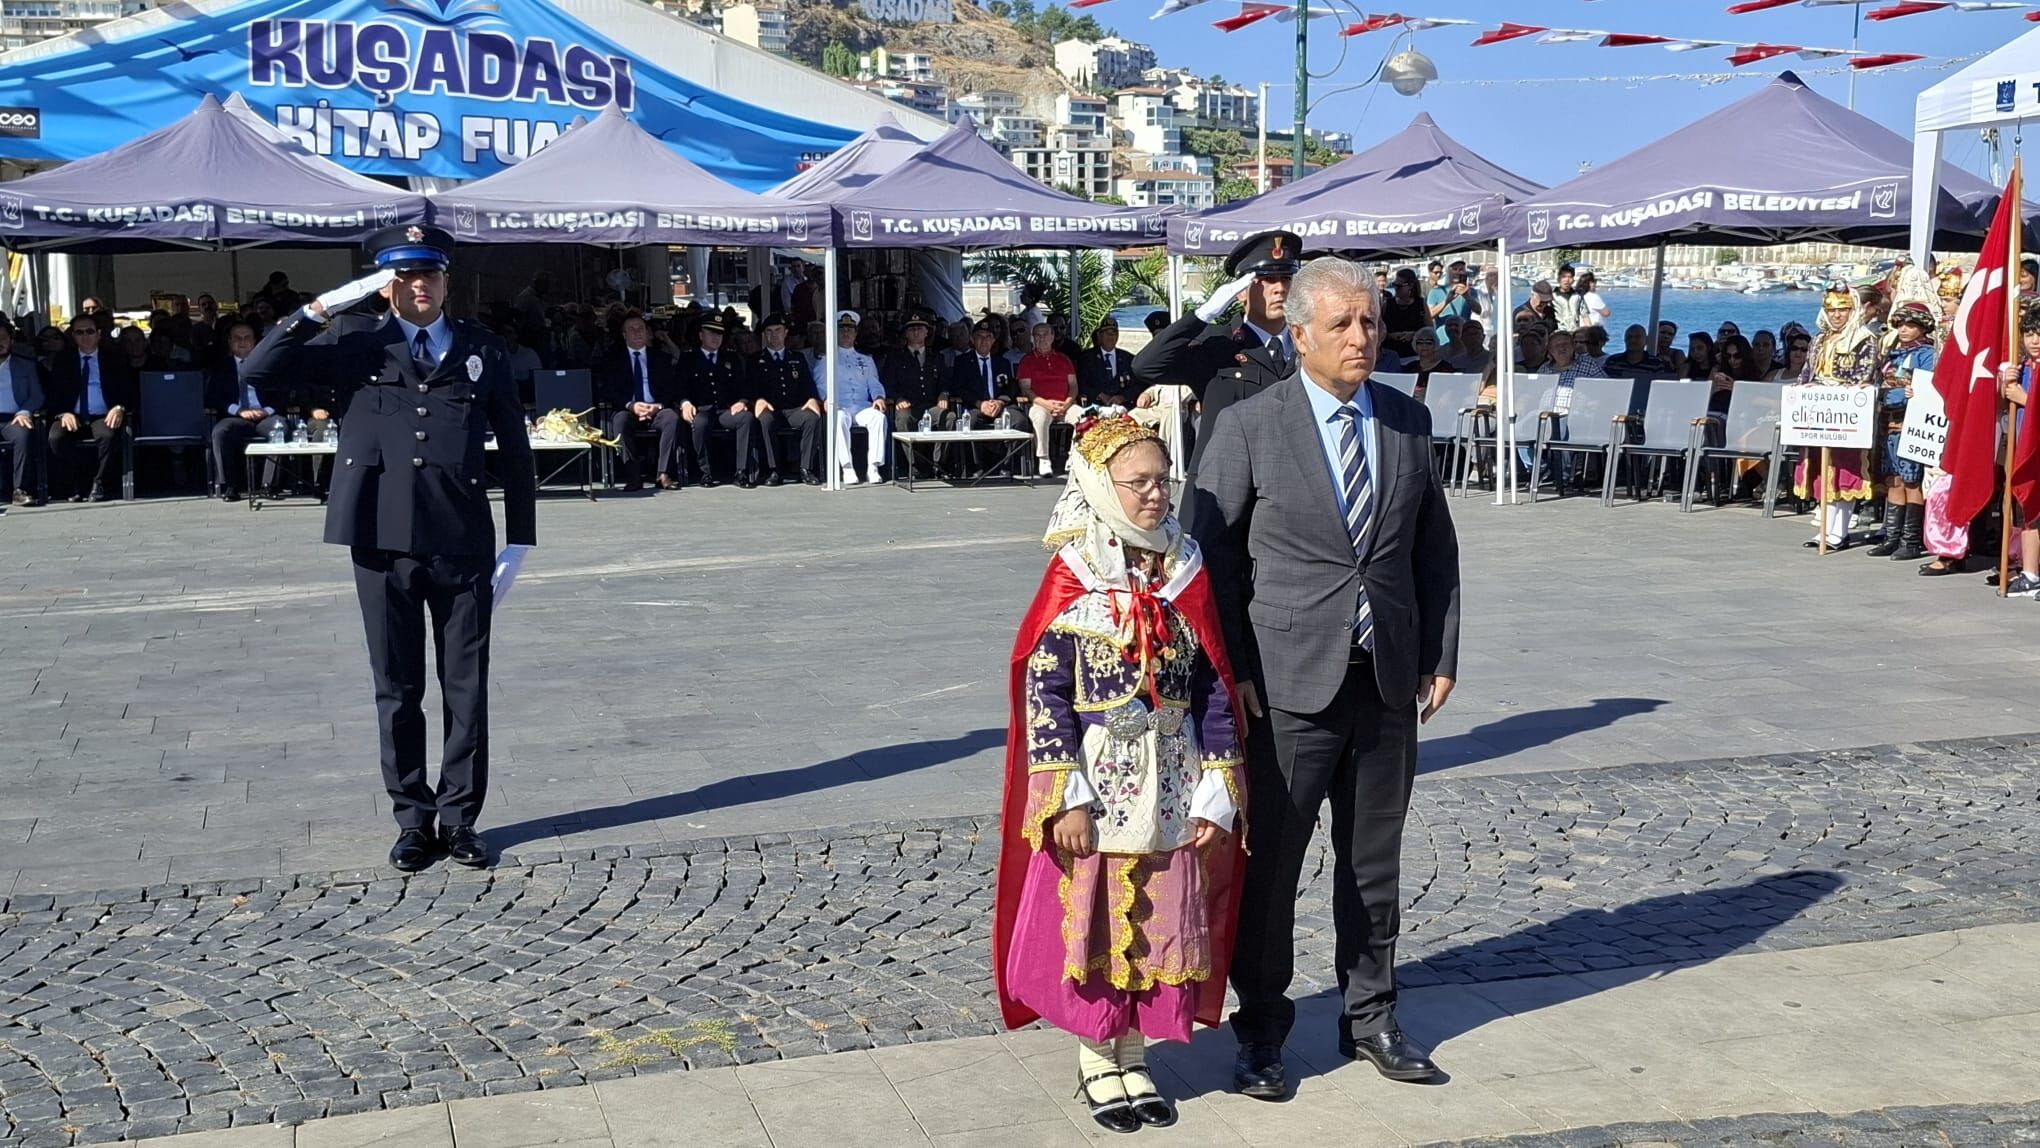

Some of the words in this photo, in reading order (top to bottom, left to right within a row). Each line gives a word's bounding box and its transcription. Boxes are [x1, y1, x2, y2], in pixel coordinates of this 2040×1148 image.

[249, 19, 634, 111] KUŞADASI
[276, 99, 440, 159] KİTAP
[461, 115, 573, 166] FUA
[33, 205, 80, 222] T.C.
[87, 204, 215, 227] KUŞADASI
[1557, 214, 1594, 231] T.C.
[1600, 191, 1713, 227] KUŞADASI
[486, 212, 527, 228] T.C.
[533, 211, 645, 232] KUŞADASI
[881, 218, 918, 233] T.C.
[922, 216, 1021, 236] KUŞADASI
[1210, 229, 1239, 241] T.C.
[1801, 392, 1849, 402] KUŞADASI
[1800, 432, 1818, 440] SPOR
[1820, 433, 1847, 441] KULÜBÜ
[1907, 426, 1935, 442] HALK
[1907, 444, 1936, 460] SPOR
